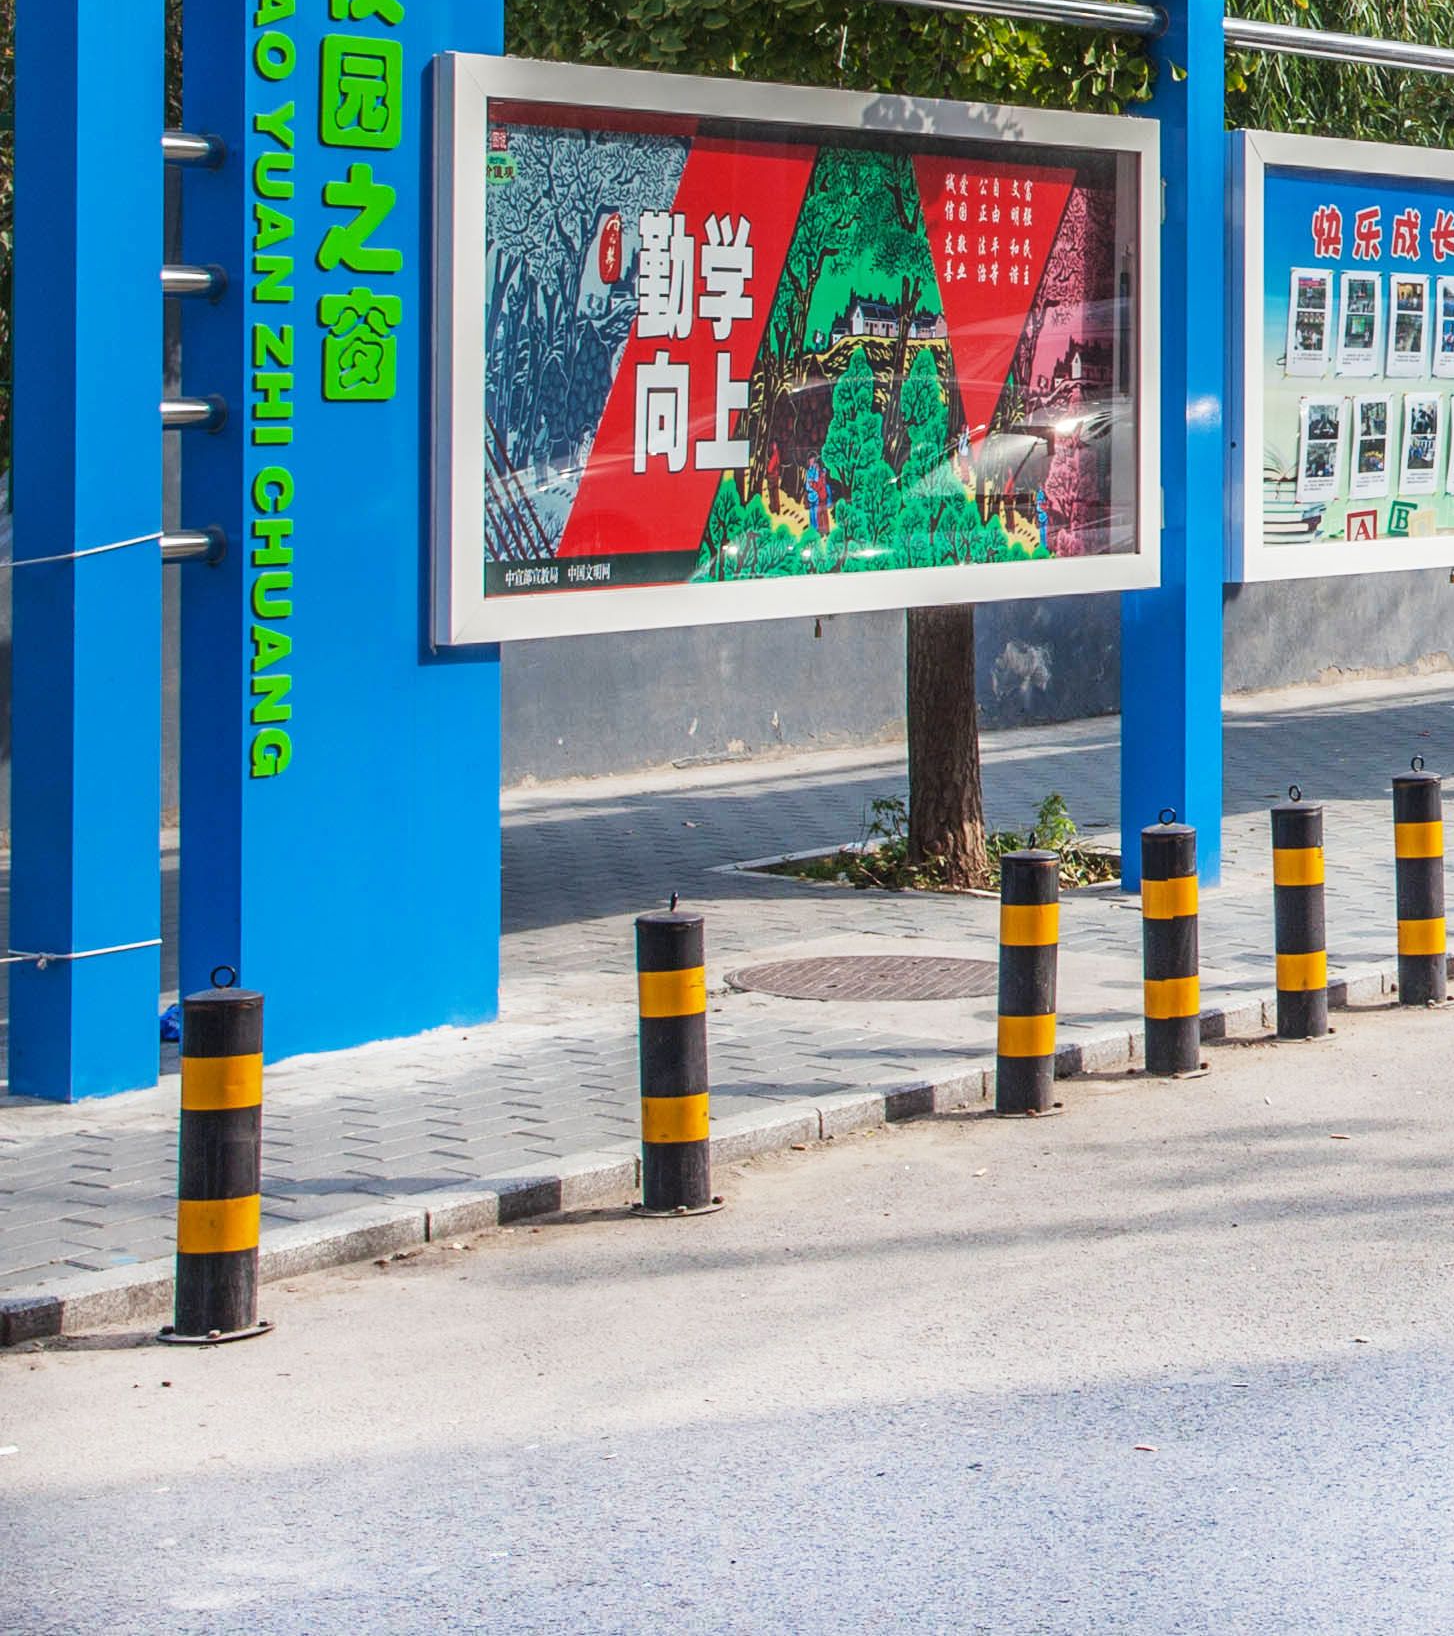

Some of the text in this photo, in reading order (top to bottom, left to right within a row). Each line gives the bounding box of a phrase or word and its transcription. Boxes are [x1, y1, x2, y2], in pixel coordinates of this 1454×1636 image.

[253, 101, 296, 303] YUAN
[944, 172, 956, 283] 诚信 友善
[958, 173, 968, 222] 爱国
[977, 177, 988, 282] 公正 法治
[989, 177, 1001, 286] 自由 平等
[1009, 179, 1021, 285] 文明 和谐
[1022, 179, 1033, 285] 富强 民主
[638, 210, 754, 341] 勤学
[253, 323, 295, 445] ZHI
[633, 350, 750, 474] 向上
[567, 563, 611, 582] 中国文明网
[1354, 518, 1372, 541] A
[251, 465, 295, 779] CHUANG
